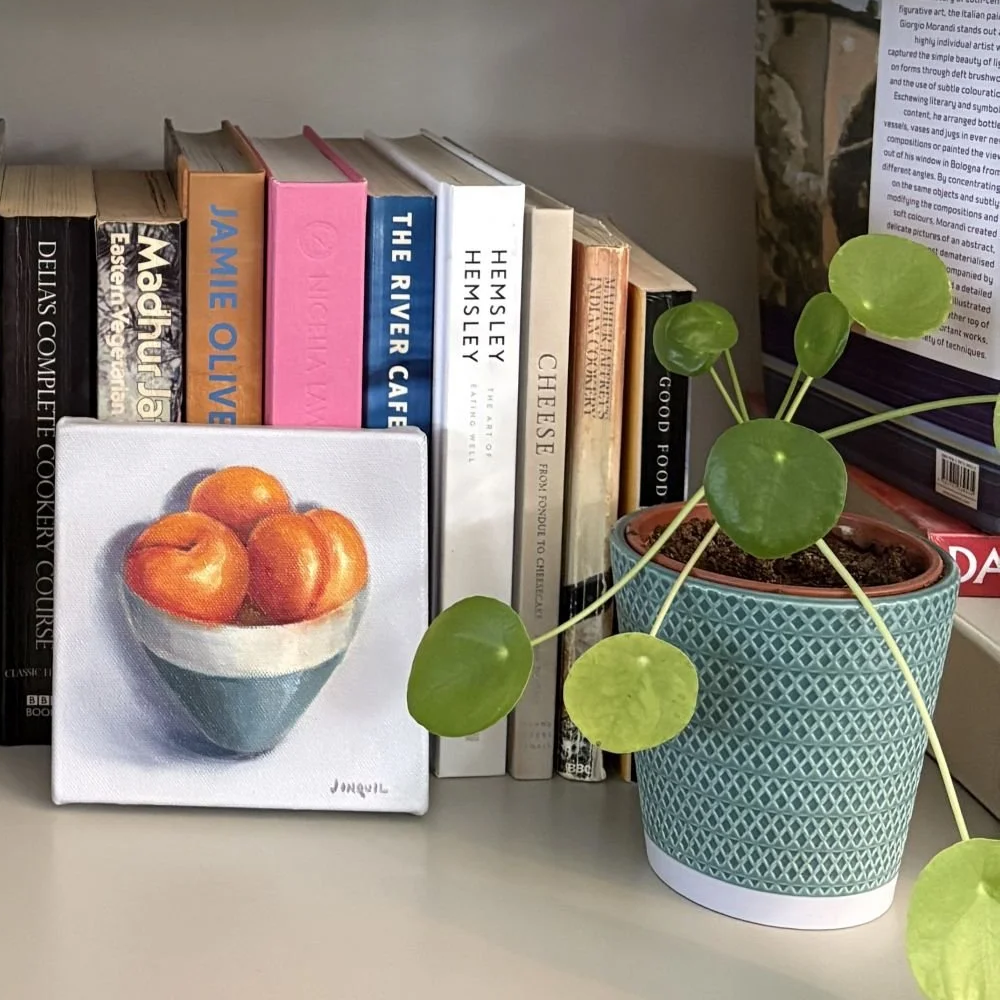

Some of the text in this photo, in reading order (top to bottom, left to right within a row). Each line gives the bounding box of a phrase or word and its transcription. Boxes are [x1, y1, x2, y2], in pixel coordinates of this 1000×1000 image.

[900, 19, 924, 31] Giorgio
[926, 22, 956, 32] Morandi
[957, 25, 981, 35] stands
[914, 36, 995, 51] highly individual artist
[37, 241, 56, 315] DELIA'S
[209, 204, 238, 309] JAMIE
[936, 217, 997, 238] Morandi created
[939, 249, 994, 268] dematerialised
[105, 233, 130, 416] Eastern Vegetarian
[137, 235, 172, 376] Madhur
[388, 212, 412, 429] THE RIVER CAFE
[462, 250, 481, 362] HEMSLEY
[489, 250, 508, 362] HEMSLEY
[584, 276, 602, 418] INDIAN COOKERY
[601, 277, 616, 342] MADHUR
[945, 339, 987, 359] techniques.
[36, 321, 56, 437] COMPLETE
[535, 353, 557, 536] CHEESE FROM FONDUE
[655, 376, 672, 497] GOOD FOOD
[35, 444, 55, 553] COOKERY
[35, 560, 54, 650] COURSE
[330, 778, 388, 798] JONQUIL
